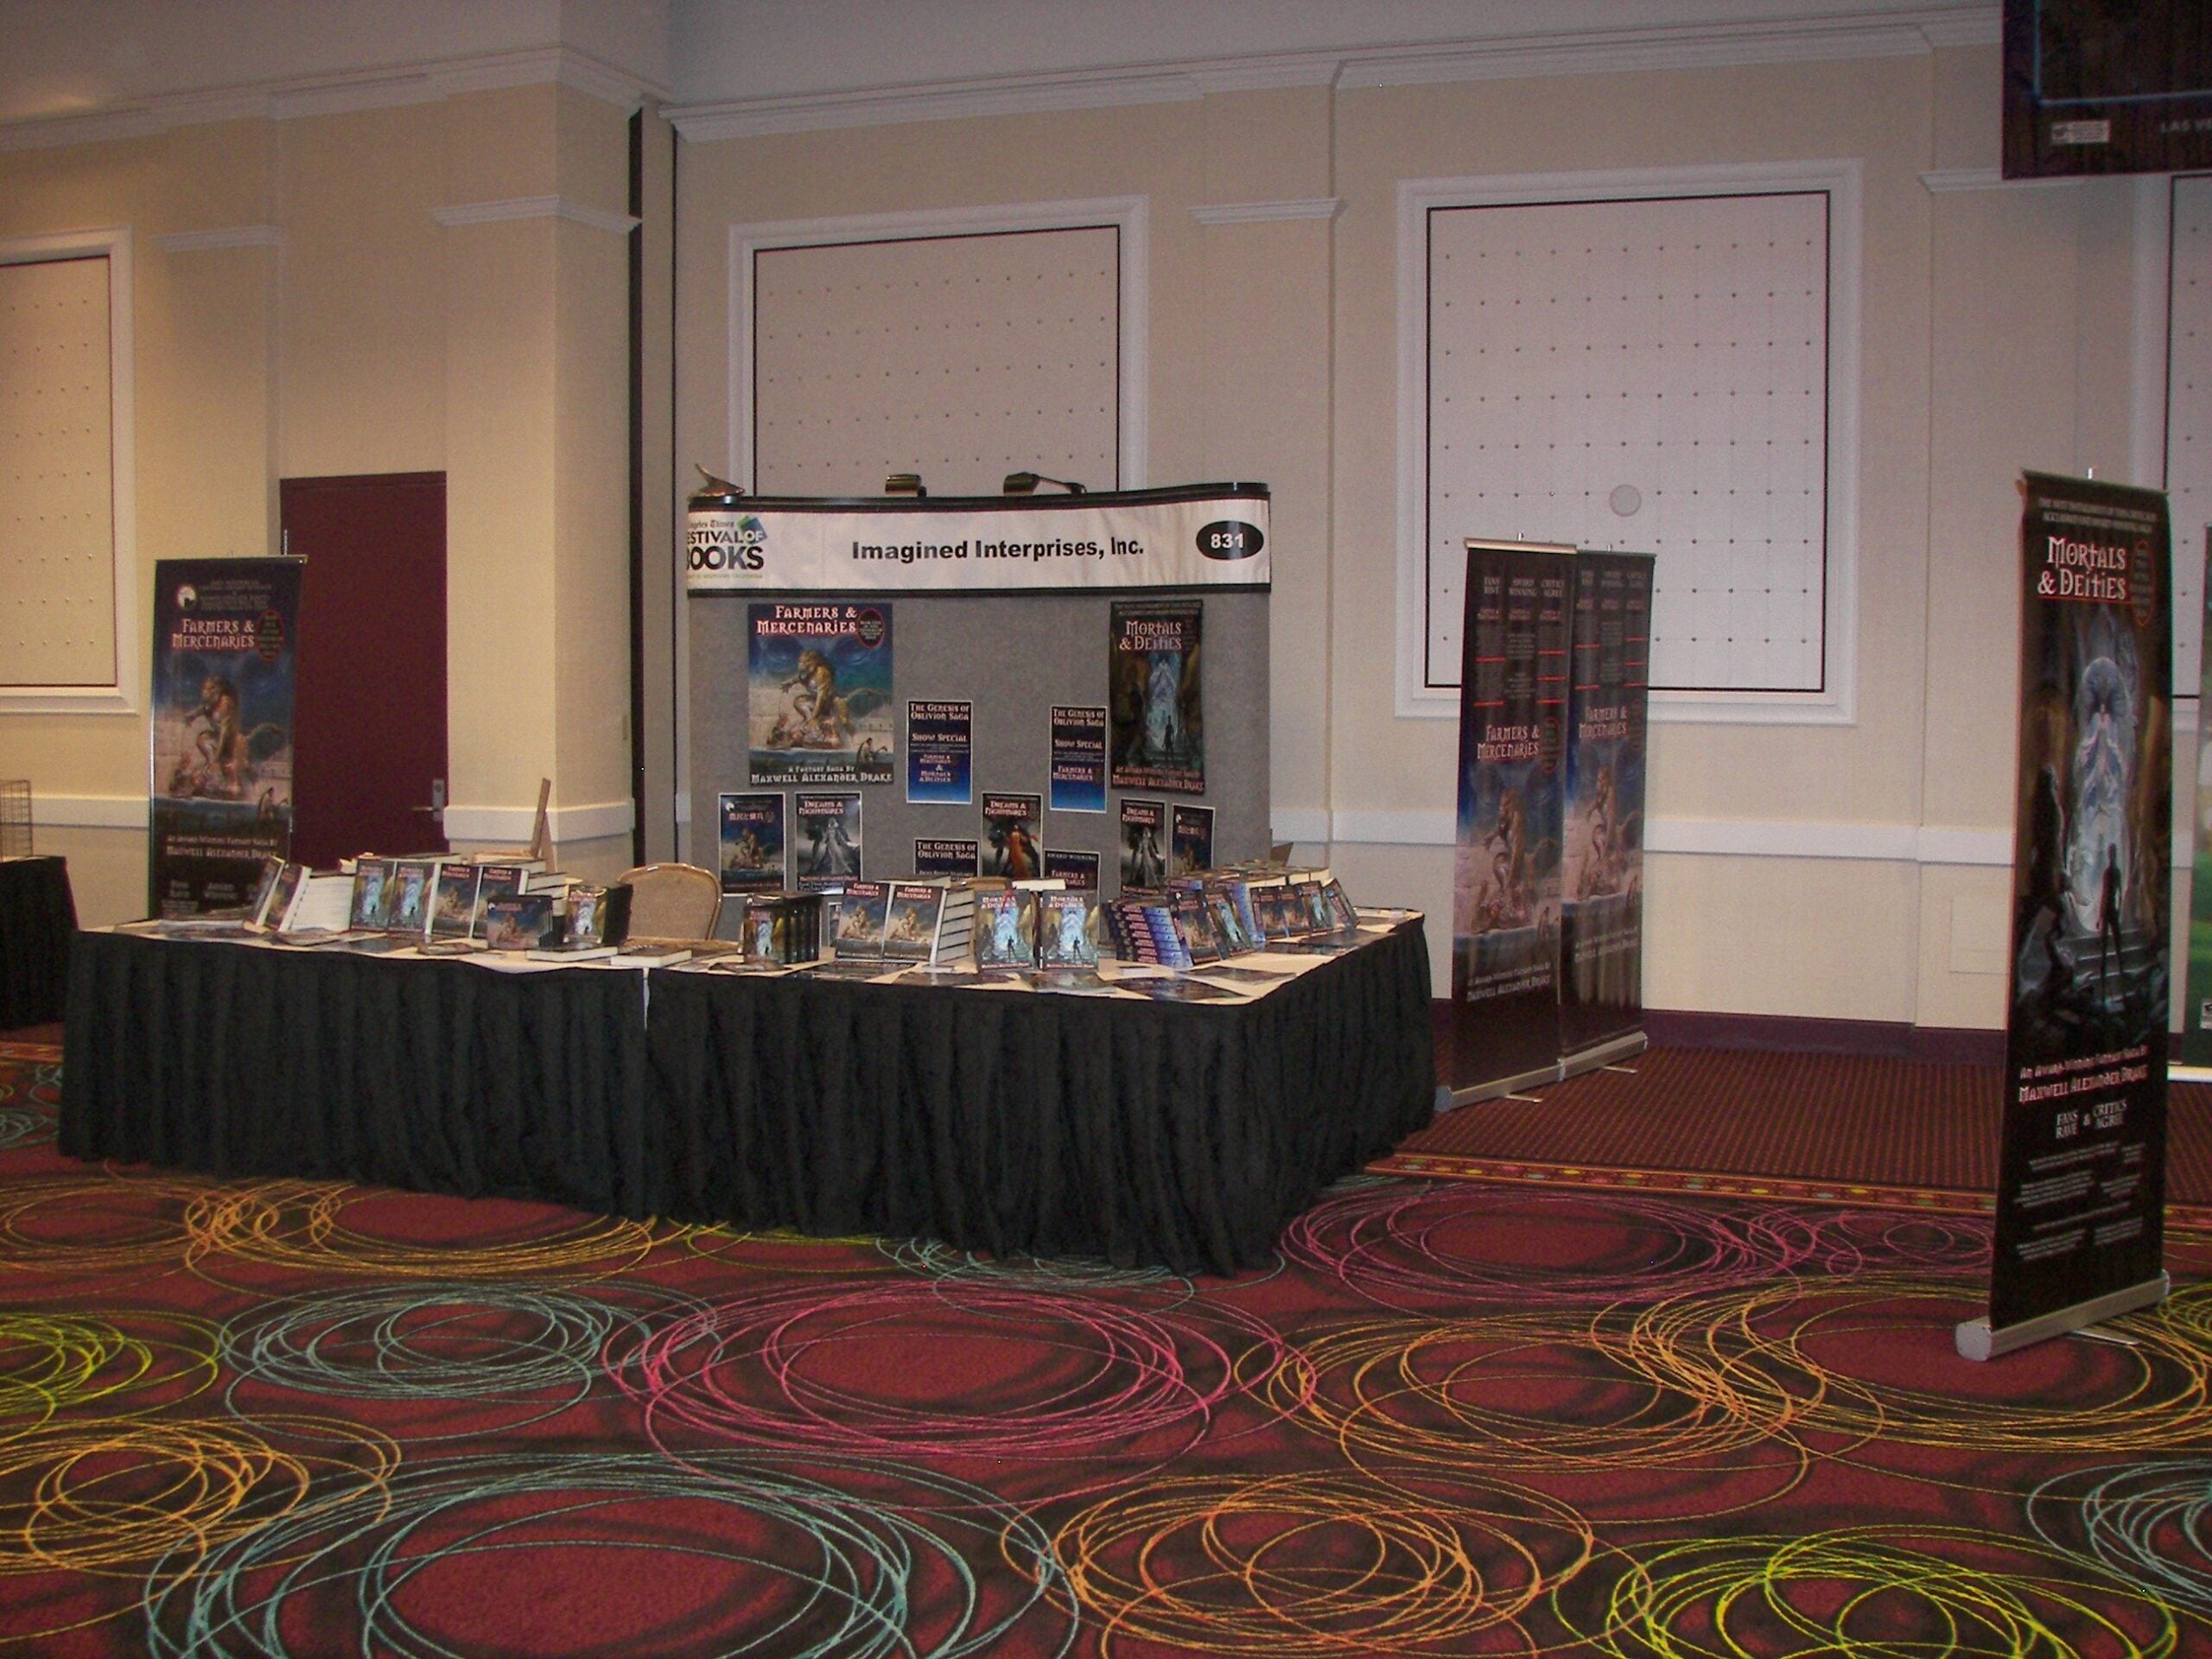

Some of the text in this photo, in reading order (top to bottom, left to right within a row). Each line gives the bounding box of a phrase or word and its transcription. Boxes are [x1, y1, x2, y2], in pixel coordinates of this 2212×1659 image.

[745, 530, 764, 543] OF
[1211, 532, 1244, 550] 831
[688, 546, 764, 570] OOKS
[853, 536, 1144, 564] Imagined Interprises, Inc.
[2037, 570, 2056, 594] &
[845, 607, 857, 619] &
[244, 620, 255, 633] &
[1119, 637, 1131, 651] &
